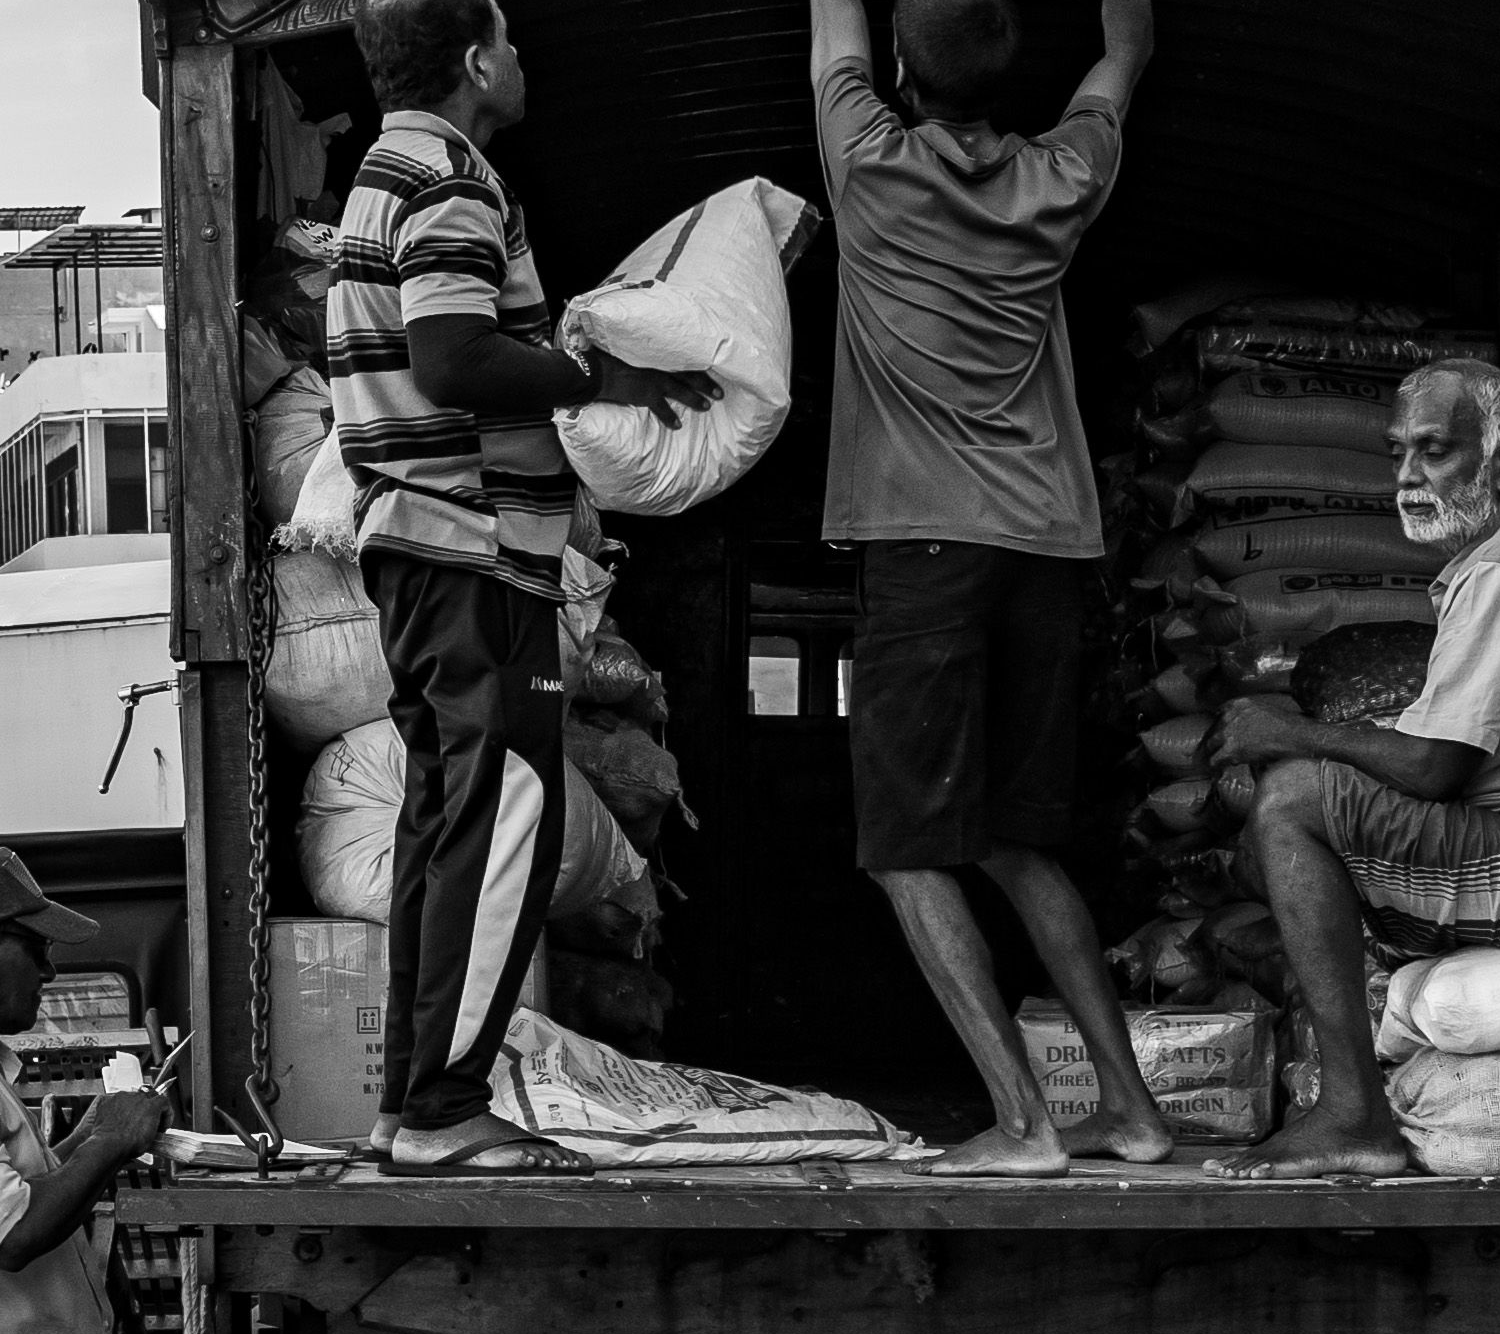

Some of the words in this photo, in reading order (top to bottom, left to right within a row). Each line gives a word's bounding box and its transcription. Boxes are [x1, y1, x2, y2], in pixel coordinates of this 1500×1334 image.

[1305, 379, 1378, 398] ALTO
[1045, 1074, 1094, 1087] THREE
[1158, 1098, 1224, 1114] ORIGIN
